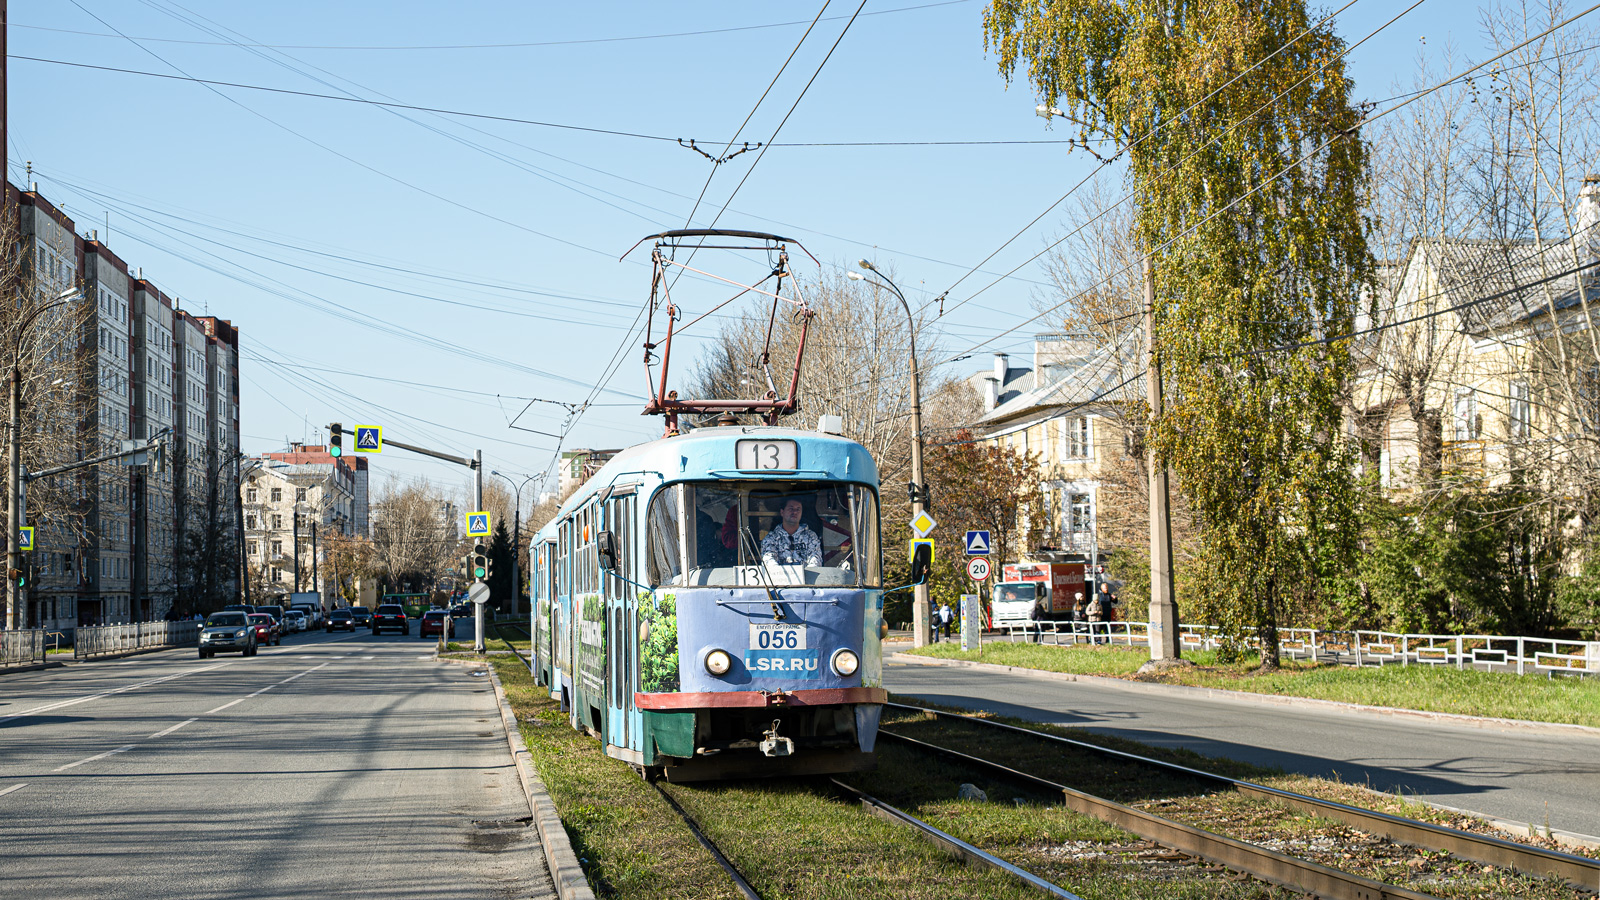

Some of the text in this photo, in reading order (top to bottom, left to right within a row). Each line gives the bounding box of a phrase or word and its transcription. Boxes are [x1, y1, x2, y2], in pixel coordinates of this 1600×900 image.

[752, 443, 780, 469] 13
[741, 568, 760, 586] 13
[973, 564, 986, 574] 20
[758, 630, 798, 649] 056
[745, 657, 818, 671] LSR.RU
